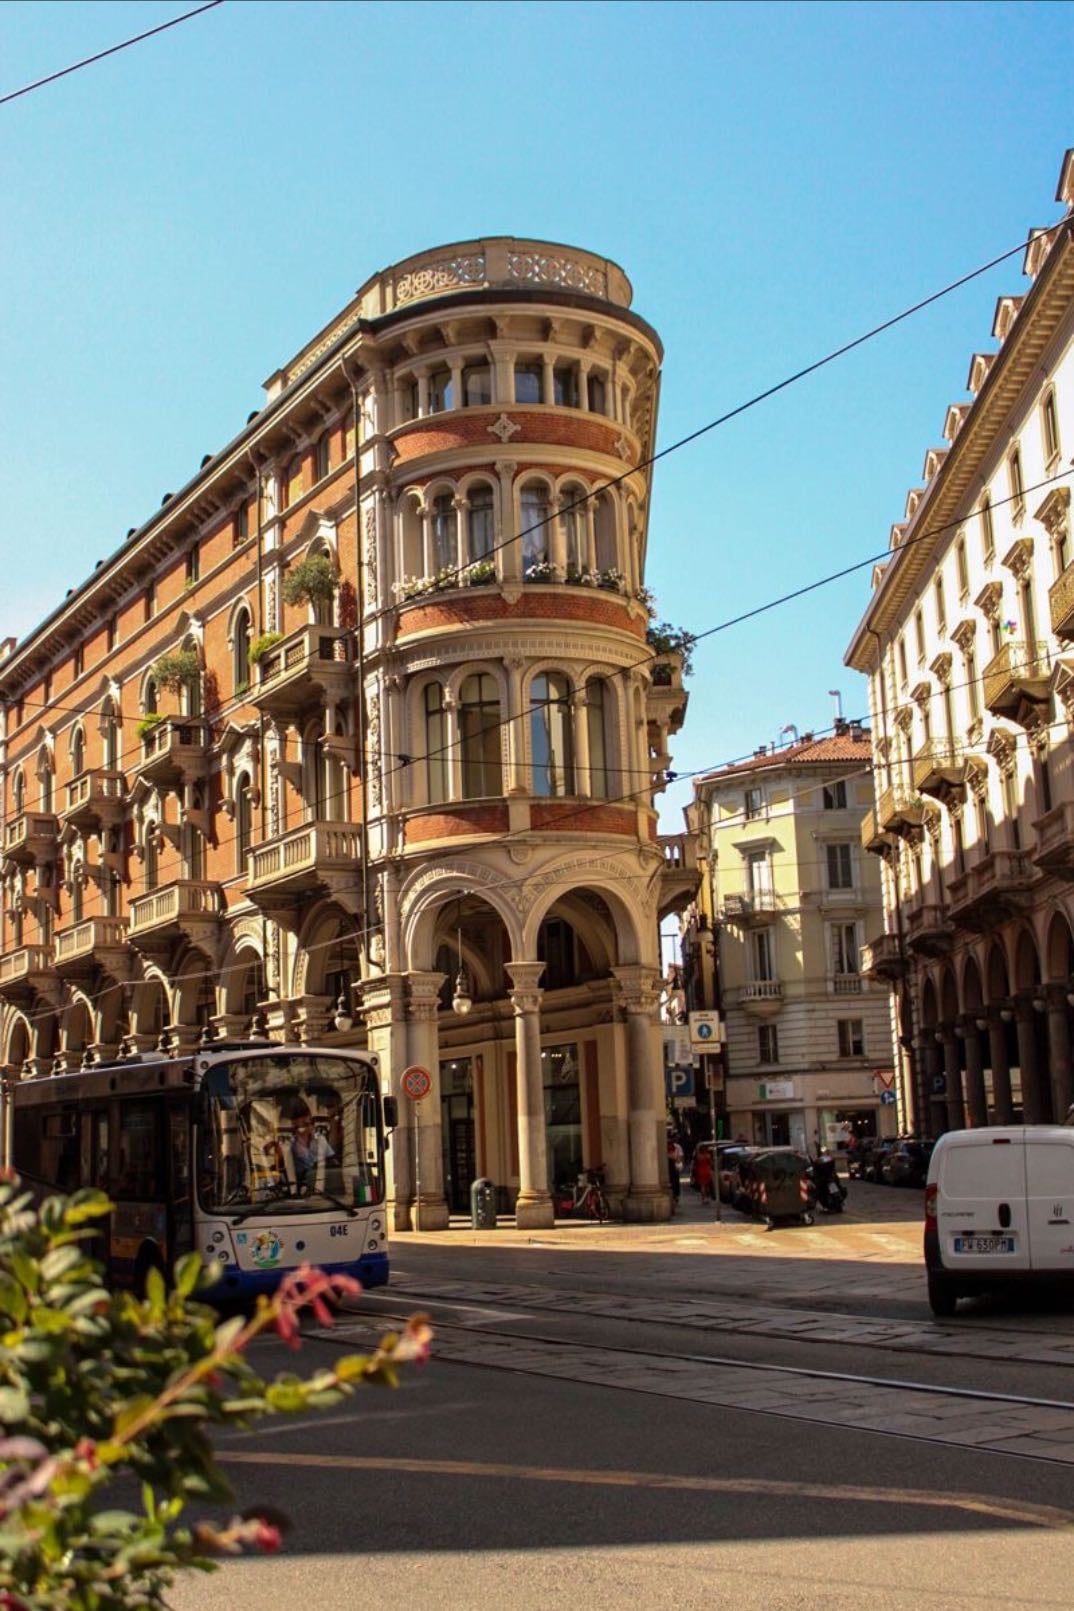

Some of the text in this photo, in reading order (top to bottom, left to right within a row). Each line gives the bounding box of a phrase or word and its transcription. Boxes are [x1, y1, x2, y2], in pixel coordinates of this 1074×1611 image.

[671, 1071, 687, 1093] P
[933, 1076, 945, 1092] P
[330, 1225, 348, 1237] 04E
